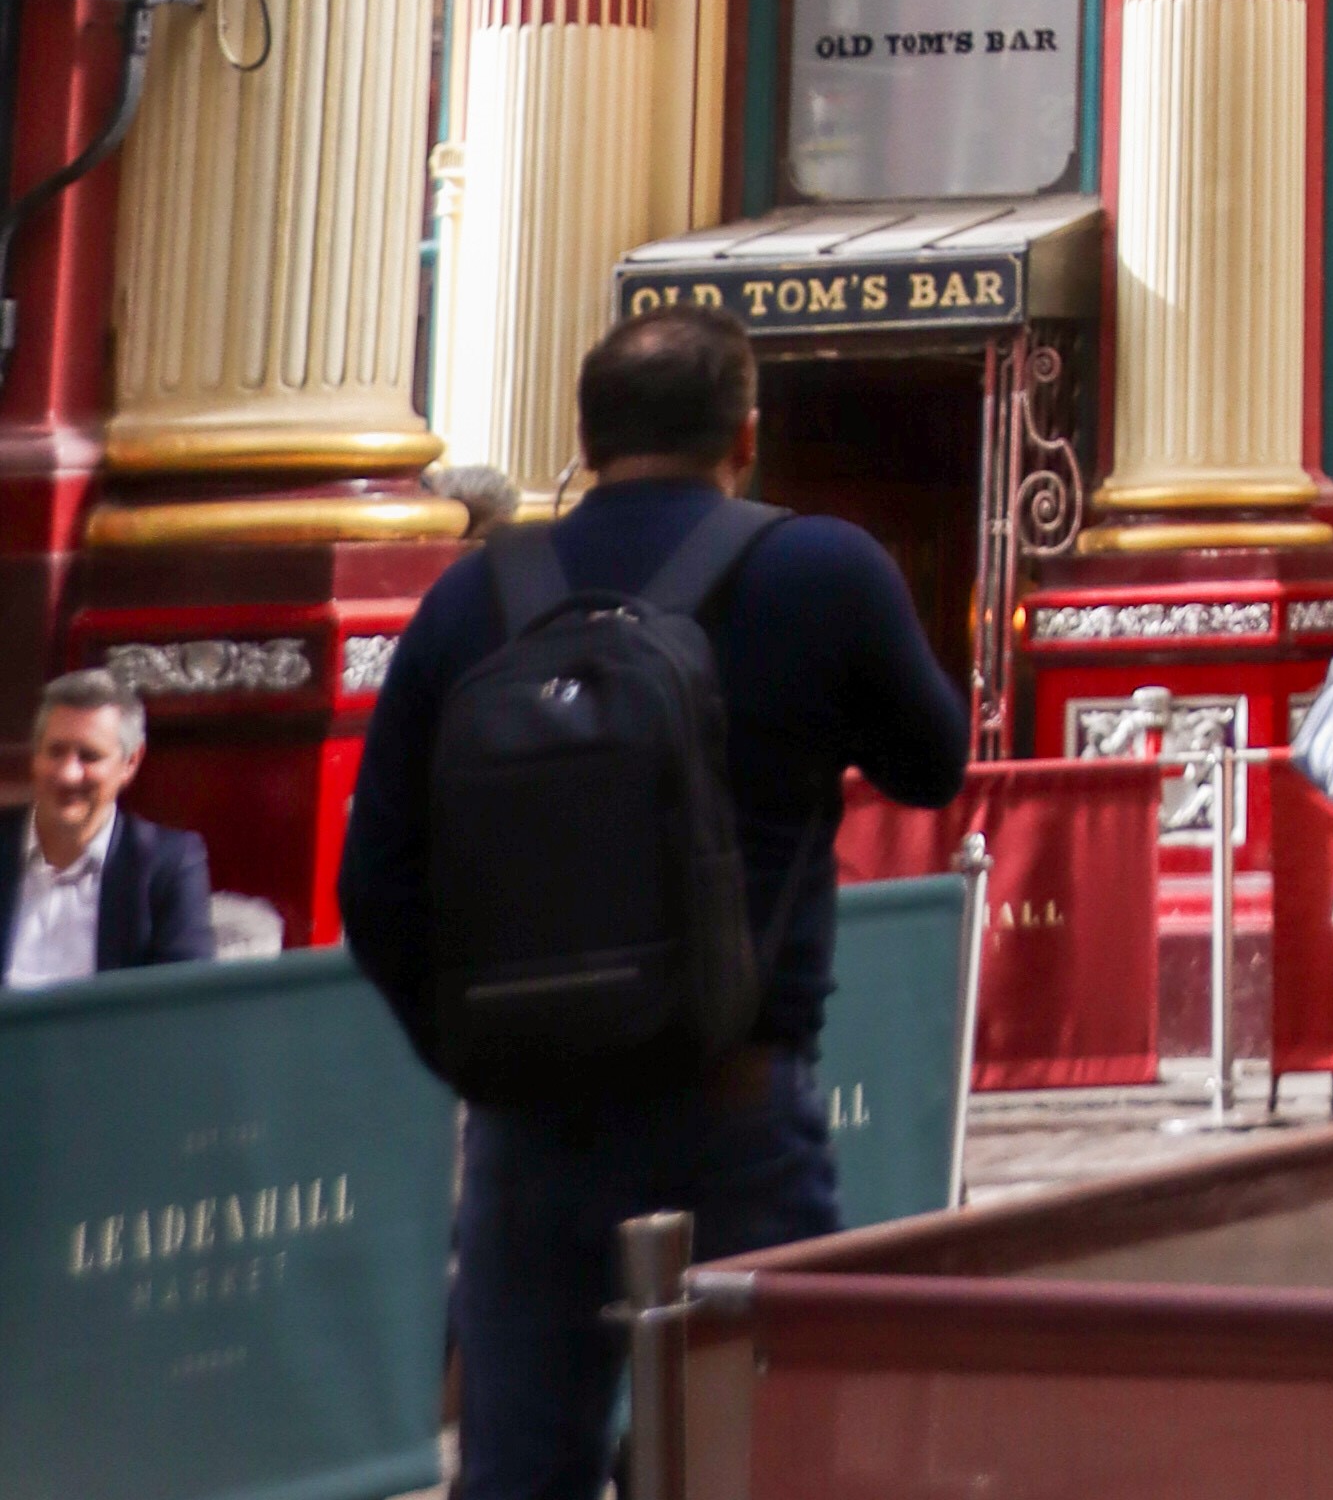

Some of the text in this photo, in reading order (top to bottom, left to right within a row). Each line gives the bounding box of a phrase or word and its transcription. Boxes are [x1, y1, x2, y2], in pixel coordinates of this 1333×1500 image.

[815, 28, 1058, 60] OLD TOM'S BAR
[742, 274, 888, 316] TOM'S
[908, 270, 1004, 308] BAR
